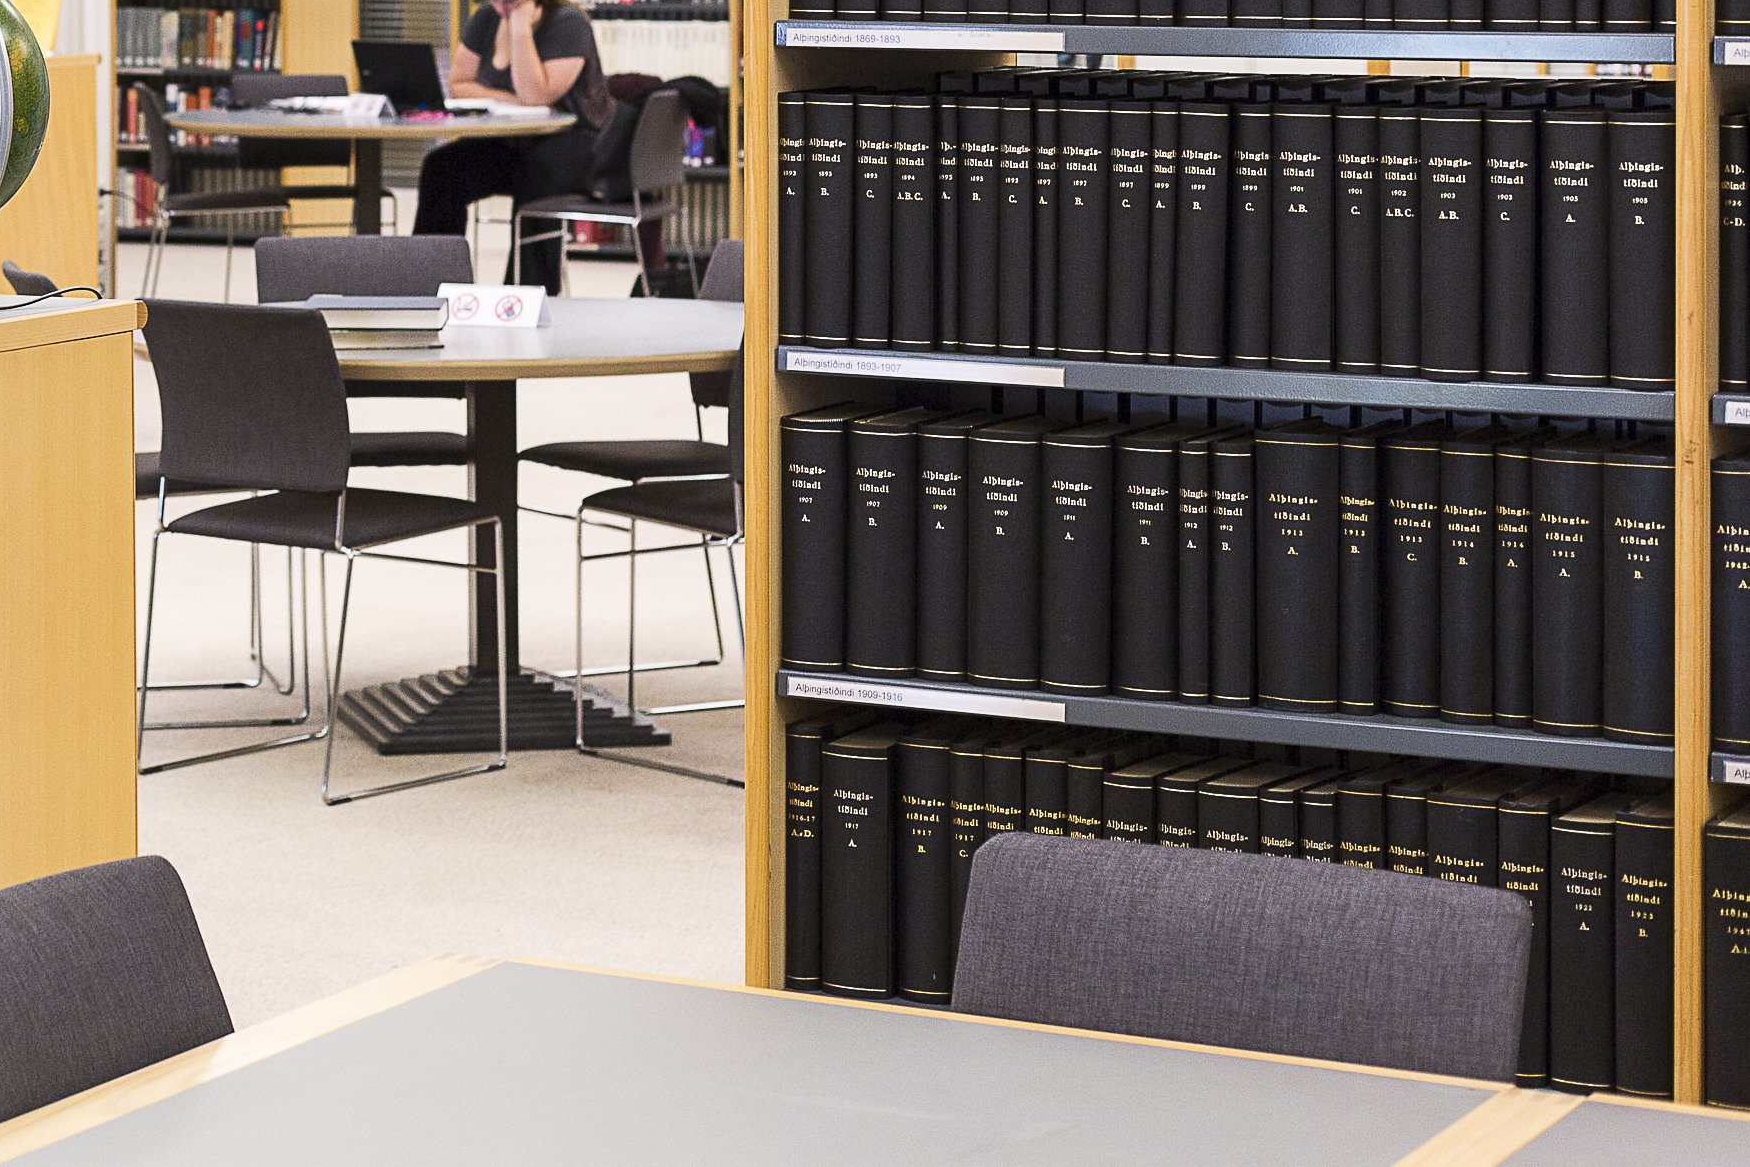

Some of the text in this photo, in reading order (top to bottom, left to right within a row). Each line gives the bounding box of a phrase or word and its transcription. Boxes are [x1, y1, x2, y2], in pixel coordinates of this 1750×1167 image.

[793, 34, 900, 43] Alþingistíðindi 1869-1893
[1280, 152, 1320, 162] Alþingis-
[1429, 157, 1471, 168] Alþingis-
[1550, 160, 1594, 171] Alþingis-
[1566, 214, 1576, 222] A.
[794, 358, 901, 372] Alþingistíðindi 1893-1907
[789, 464, 826, 475] Alþingis-
[983, 476, 1023, 487] Alþingis-
[1269, 494, 1317, 504] Alþingis-
[802, 514, 810, 522] A.
[1540, 514, 1589, 525] Alþingis-
[996, 527, 1004, 535] B.
[1288, 547, 1298, 555] A.
[1559, 568, 1570, 577] A.
[796, 684, 902, 702] Alþingistíðindi 1909-1916
[834, 790, 873, 801] Alþingis-
[849, 839, 857, 847] A.
